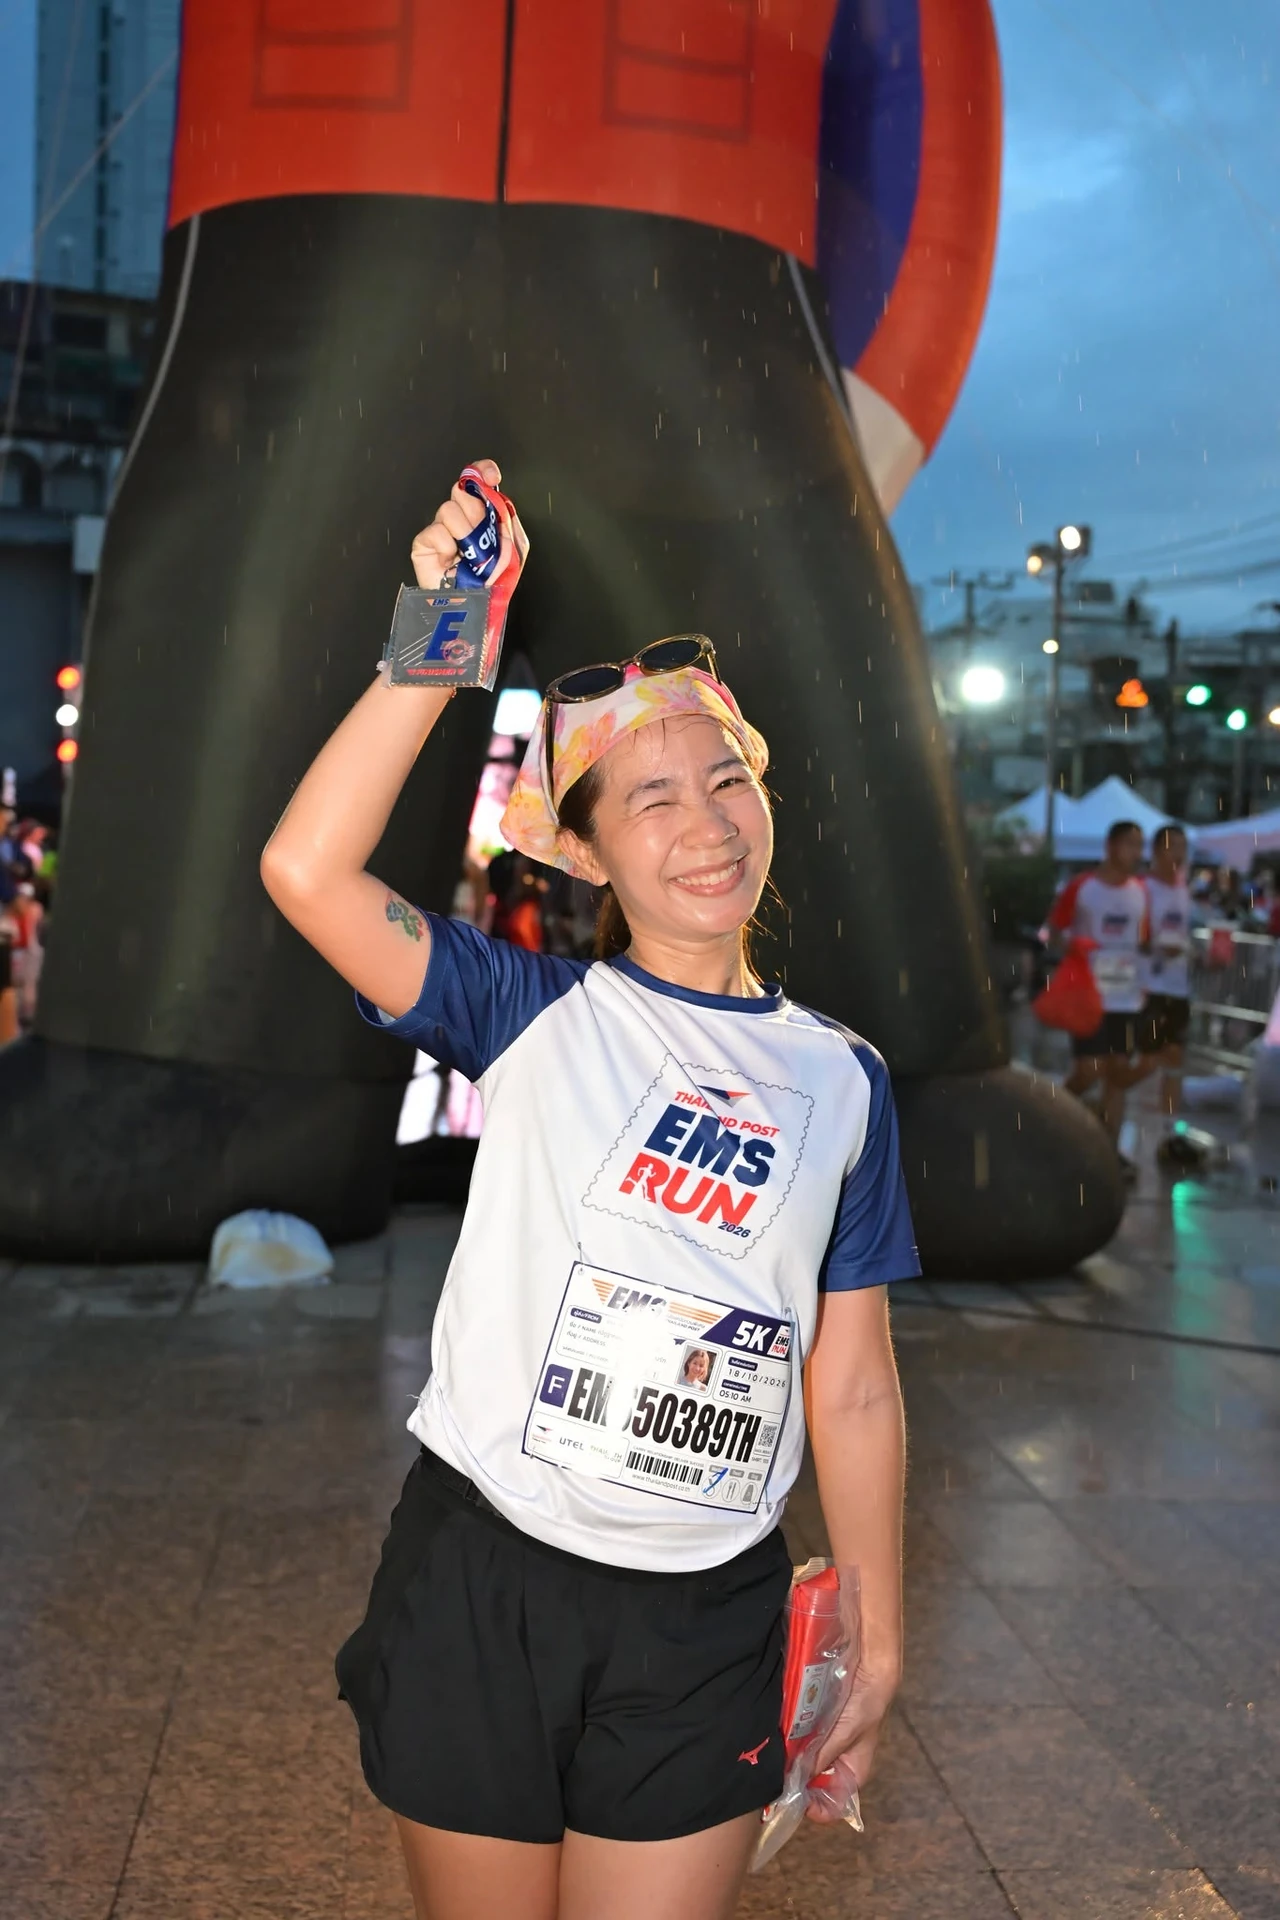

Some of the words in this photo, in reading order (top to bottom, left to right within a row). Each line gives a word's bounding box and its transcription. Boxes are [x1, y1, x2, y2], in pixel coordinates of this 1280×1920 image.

[432, 598, 450, 607] EMS
[423, 611, 468, 660] E
[740, 1116, 780, 1137] POST
[644, 1103, 776, 1187] EMS
[618, 1152, 757, 1226] RUN
[718, 1221, 751, 1238] 2026
[582, 1325, 597, 1334] NAME
[732, 1320, 772, 1352] 5K
[582, 1336, 606, 1347] ADDRESS
[775, 1336, 790, 1346] EMS
[771, 1345, 787, 1355] RUN
[548, 1375, 565, 1394] F
[741, 1395, 751, 1403] AM
